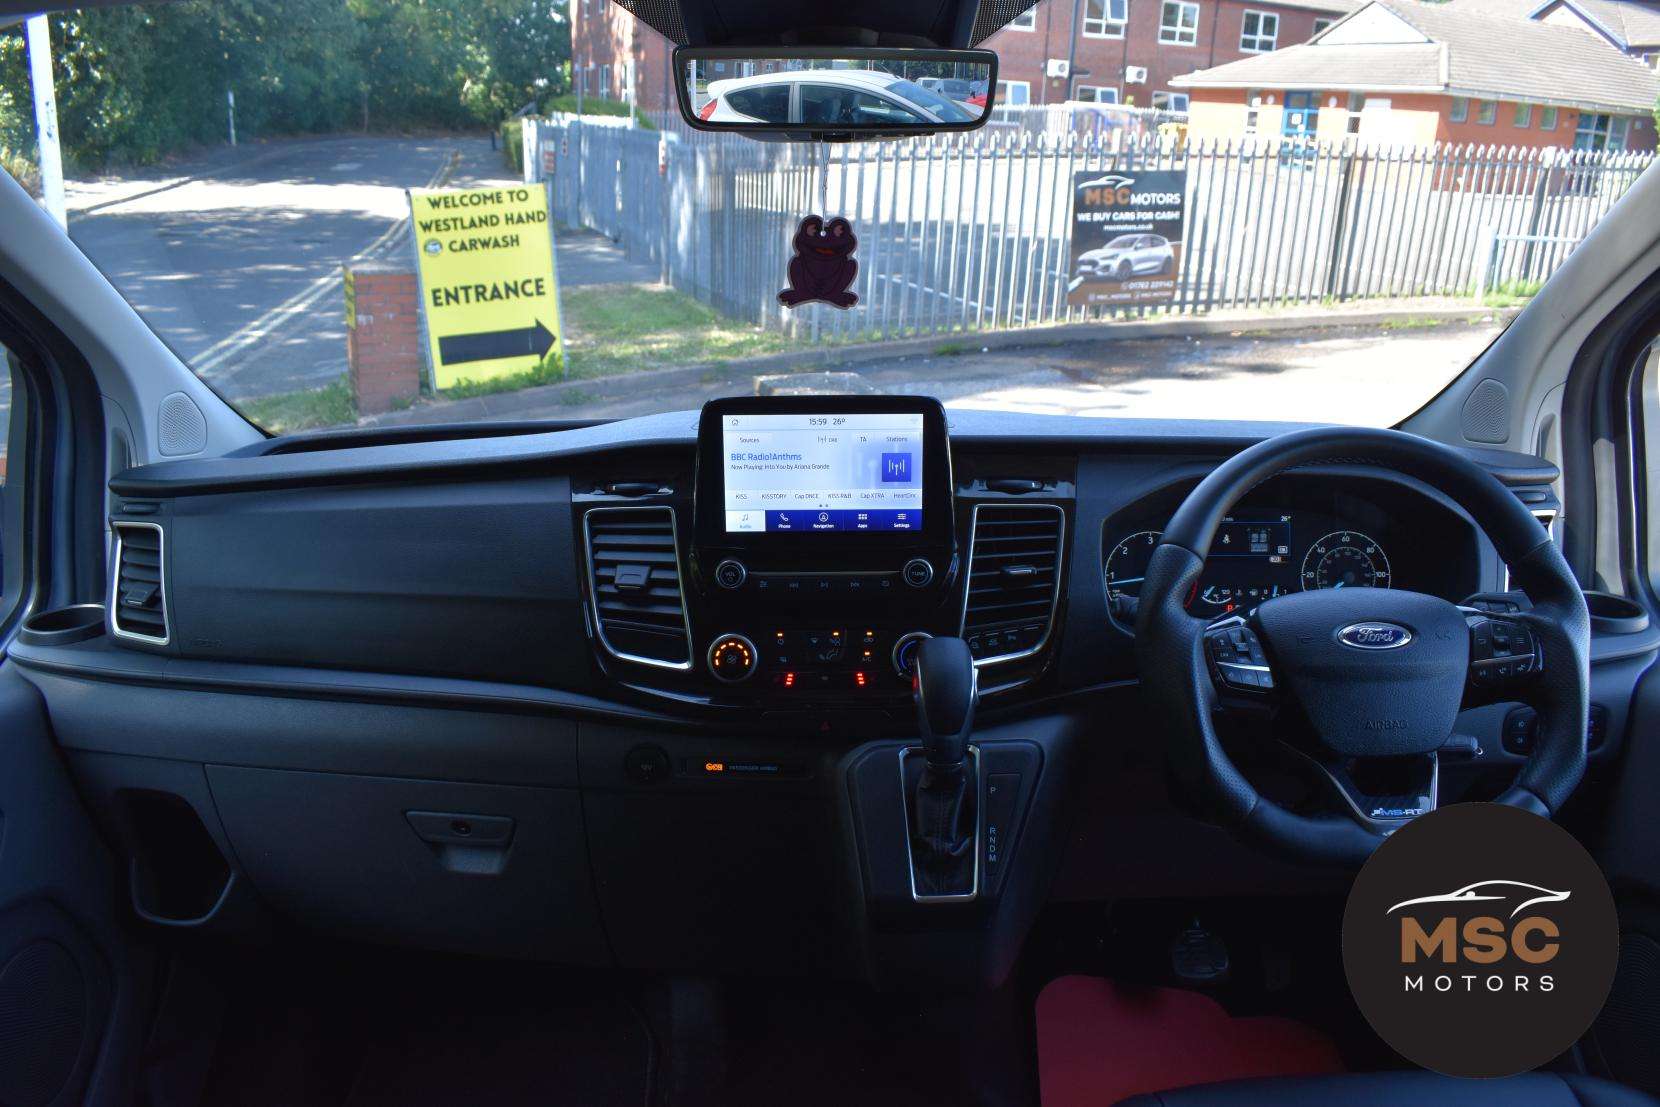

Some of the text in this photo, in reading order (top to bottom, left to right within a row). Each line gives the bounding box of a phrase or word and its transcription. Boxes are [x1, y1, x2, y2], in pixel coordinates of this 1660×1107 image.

[427, 189, 529, 209] WELCOME TO
[1084, 188, 1181, 206] MSC MOTORS
[419, 210, 546, 233] WESTLAND HAND
[1077, 212, 1091, 222] WE
[1093, 212, 1112, 221] BUY
[1112, 211, 1136, 221] CARS
[1136, 211, 1154, 220] FOR
[449, 234, 520, 253] CARWASH
[431, 278, 546, 308] ENTRANCE
[808, 418, 827, 426] 15:59
[731, 453, 747, 461] BBC
[1147, 536, 1154, 545] 3
[1122, 546, 1128, 555] 2
[1357, 627, 1394, 642] Ford
[990, 786, 996, 794] P
[989, 836, 996, 844] N
